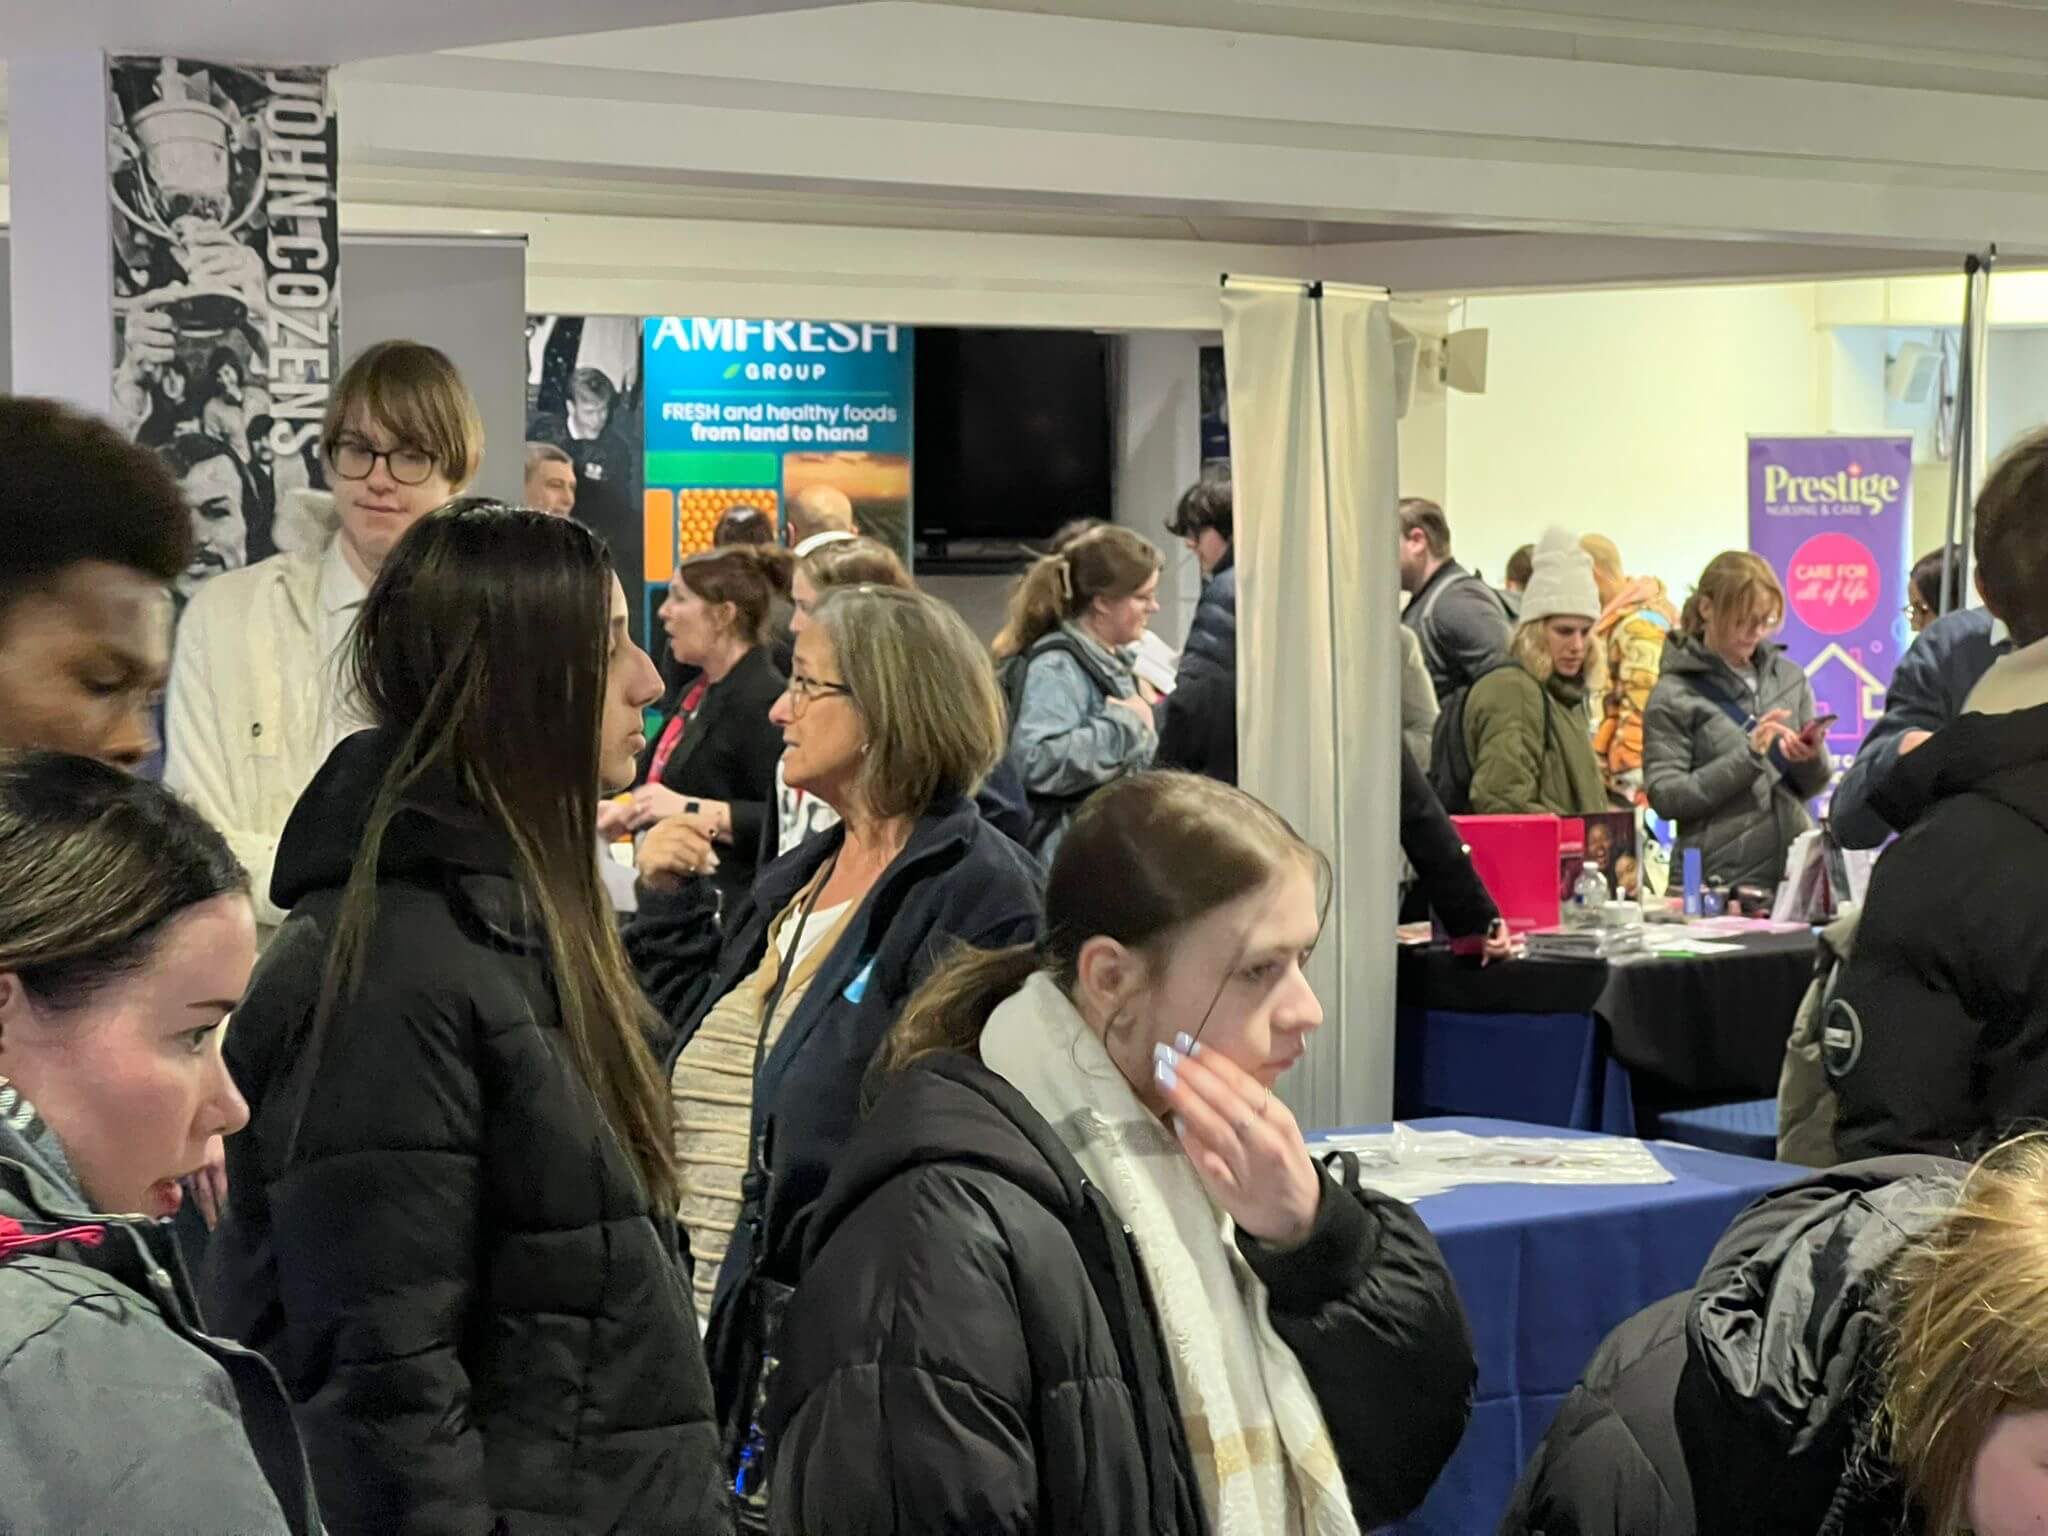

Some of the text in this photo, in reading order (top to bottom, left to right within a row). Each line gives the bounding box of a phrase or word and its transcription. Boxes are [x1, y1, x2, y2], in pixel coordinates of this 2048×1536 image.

[265, 72, 330, 456] JOHN COZENS
[652, 316, 898, 353] AMFRESH
[744, 363, 827, 381] GROUP
[662, 402, 897, 426] FRESH and healthy foods
[691, 422, 868, 442] from land to hand
[1764, 463, 1899, 515] Prestige
[1795, 564, 1868, 580] CARE FOR
